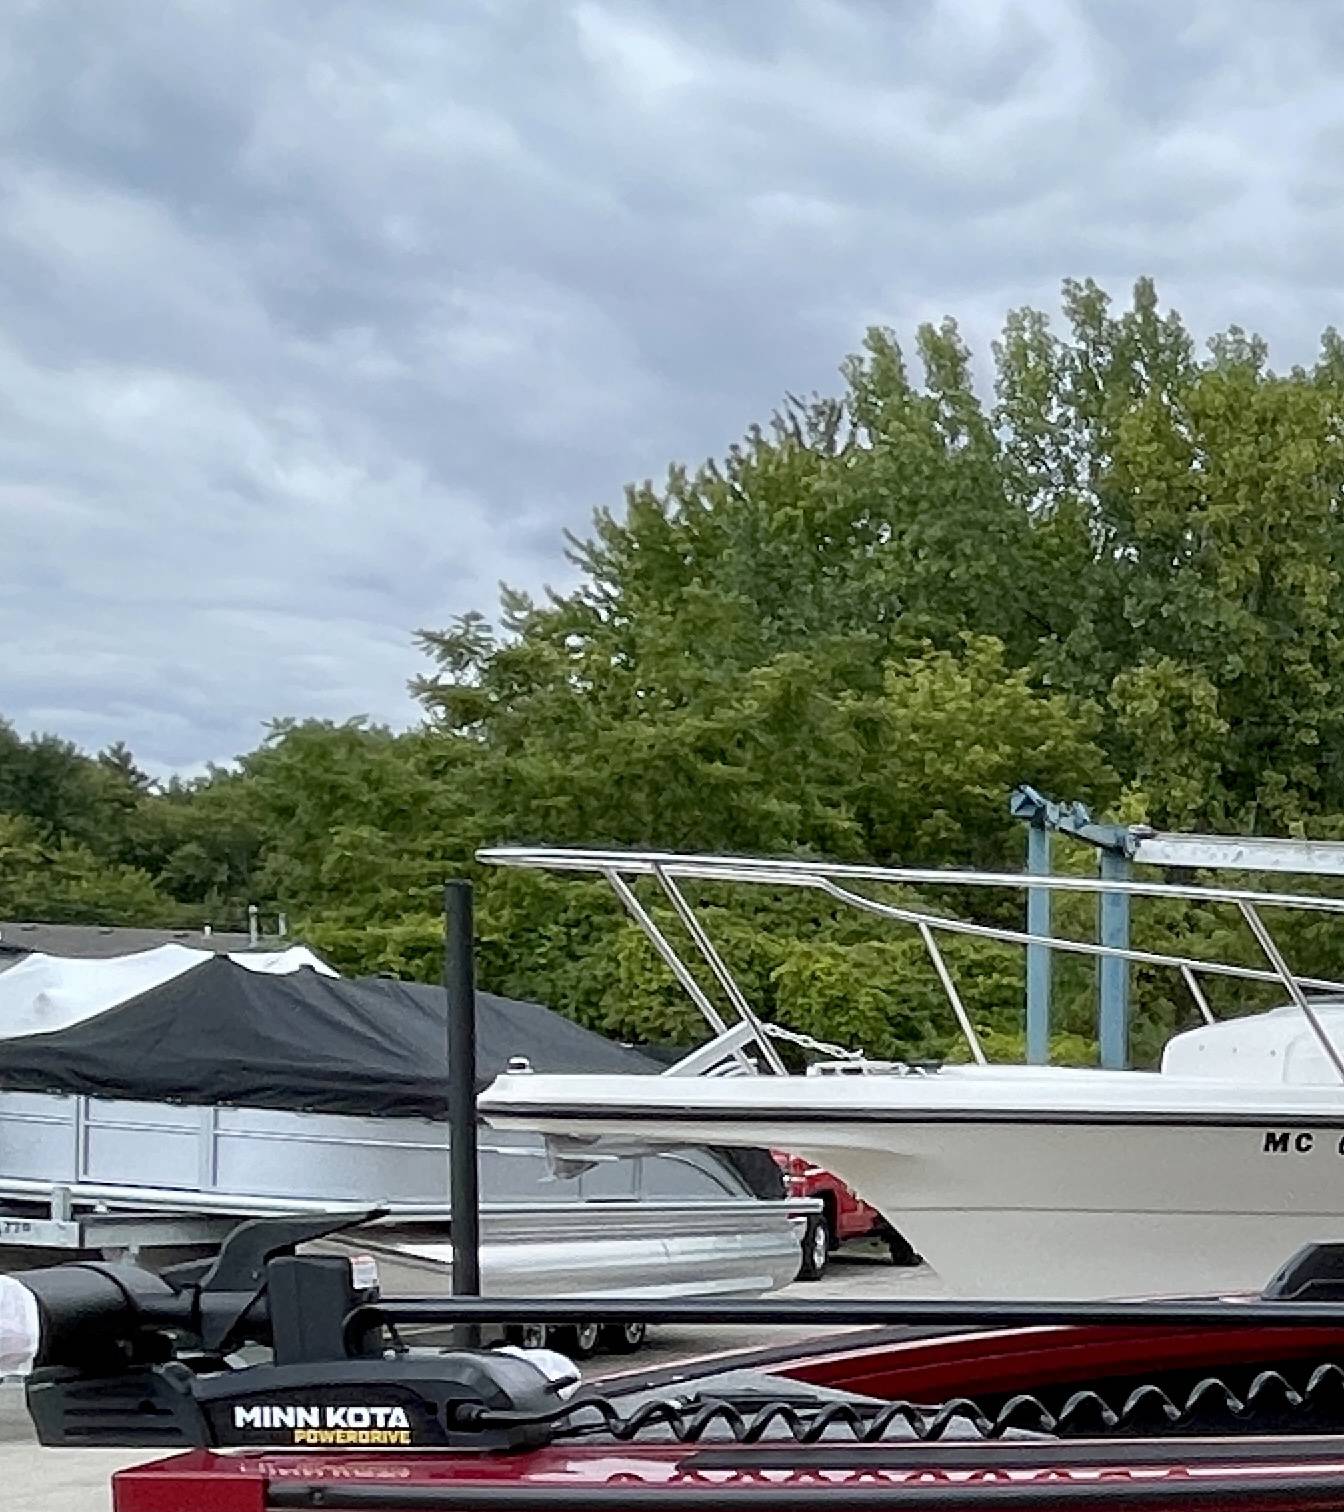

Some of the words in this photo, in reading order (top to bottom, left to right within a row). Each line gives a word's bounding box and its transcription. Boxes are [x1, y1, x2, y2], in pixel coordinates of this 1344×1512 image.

[1263, 1132, 1313, 1153] MC
[234, 1406, 320, 1428] MINN
[326, 1406, 410, 1428] KOTA
[294, 1429, 412, 1444] POWERDRIVE
